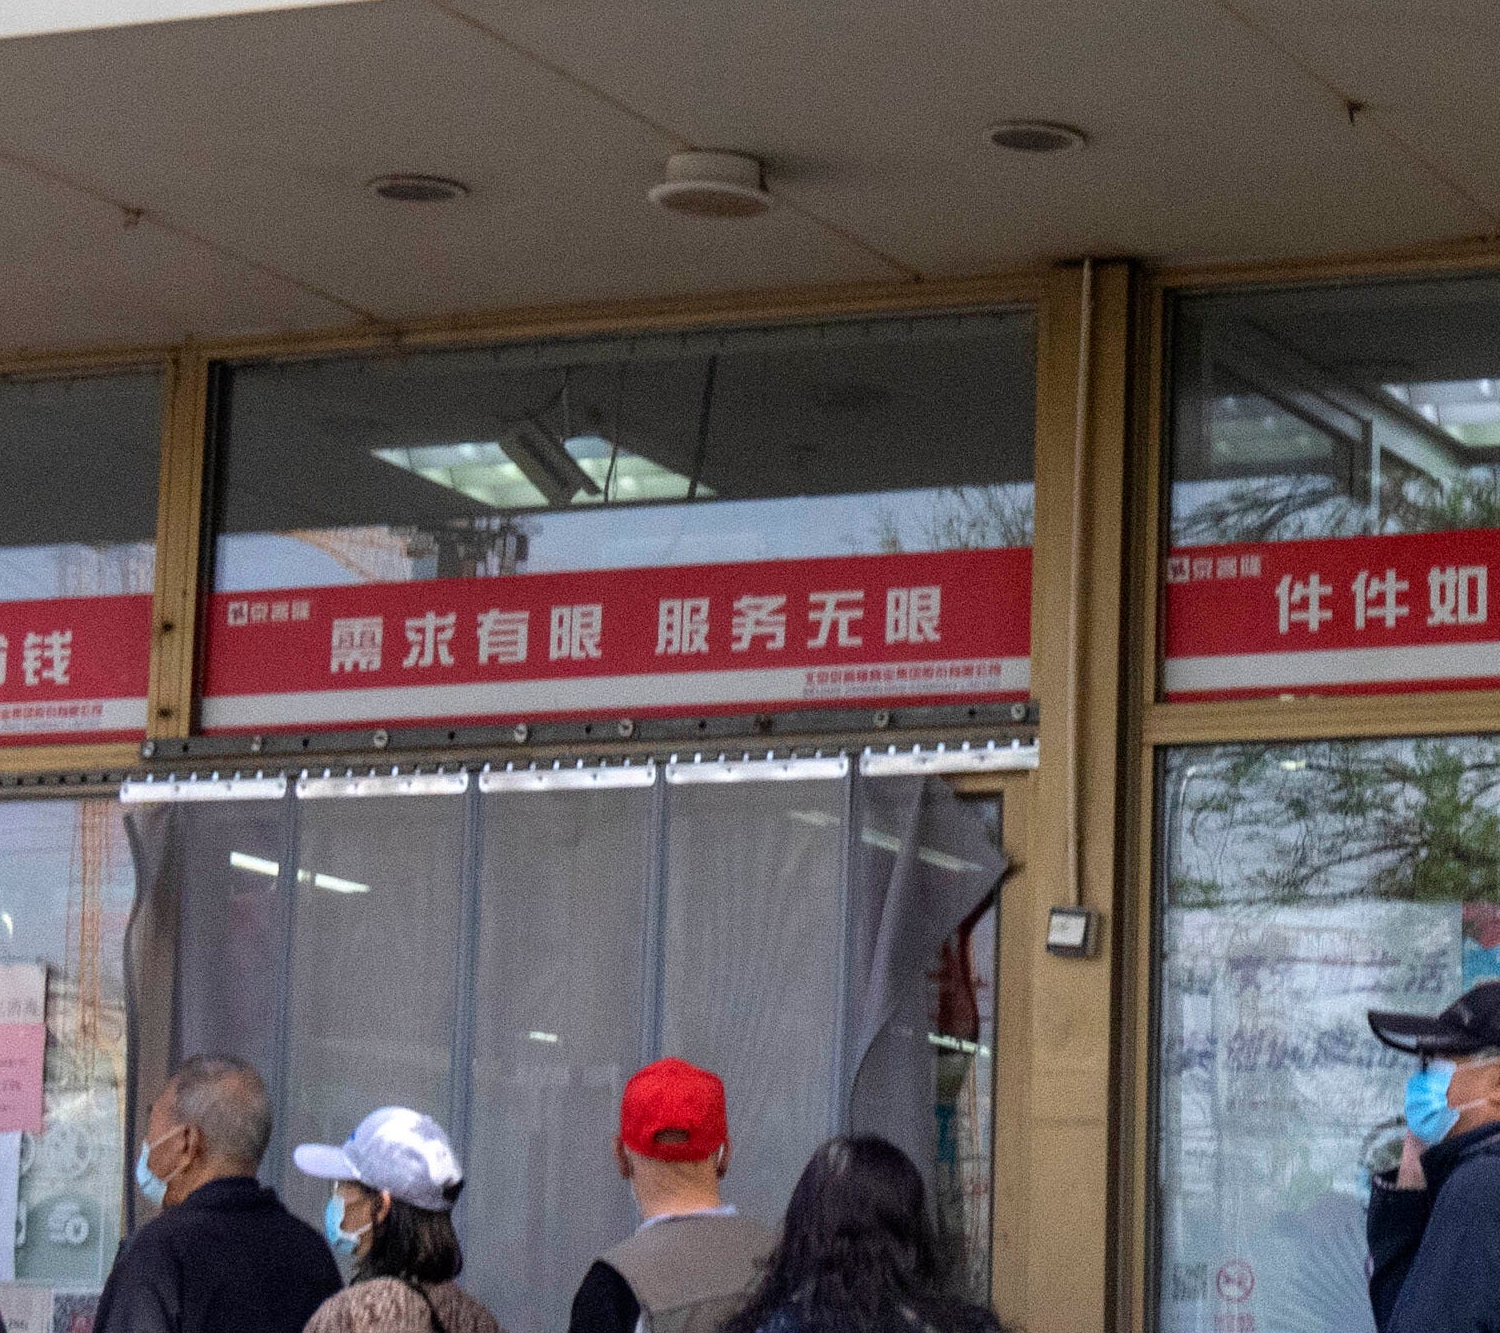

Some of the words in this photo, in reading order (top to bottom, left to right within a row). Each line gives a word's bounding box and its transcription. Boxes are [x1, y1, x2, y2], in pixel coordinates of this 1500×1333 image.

[328, 600, 603, 677] 需求有限
[654, 583, 945, 659] 服务无限
